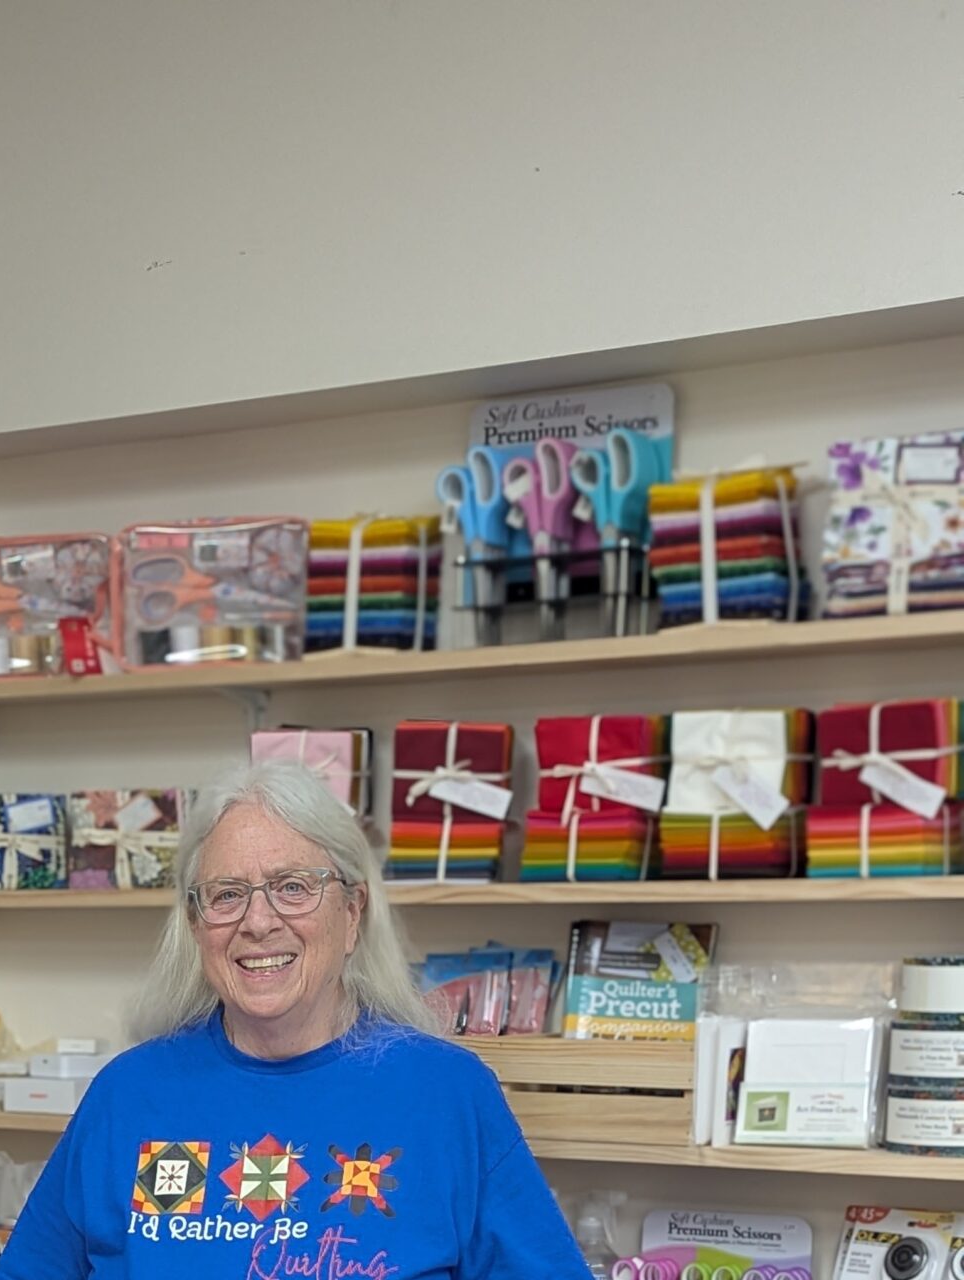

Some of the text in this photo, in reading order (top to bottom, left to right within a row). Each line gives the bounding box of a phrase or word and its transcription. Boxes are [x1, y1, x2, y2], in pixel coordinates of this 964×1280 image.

[484, 398, 586, 428] Soft Cushion
[483, 422, 577, 446] Premium
[603, 980, 677, 998] Quilter's
[586, 990, 682, 1020] Precut
[127, 1212, 308, 1244] I'd Rather Be
[668, 1211, 734, 1227] Soft Cushion
[668, 1222, 782, 1241] Premium Scissors
